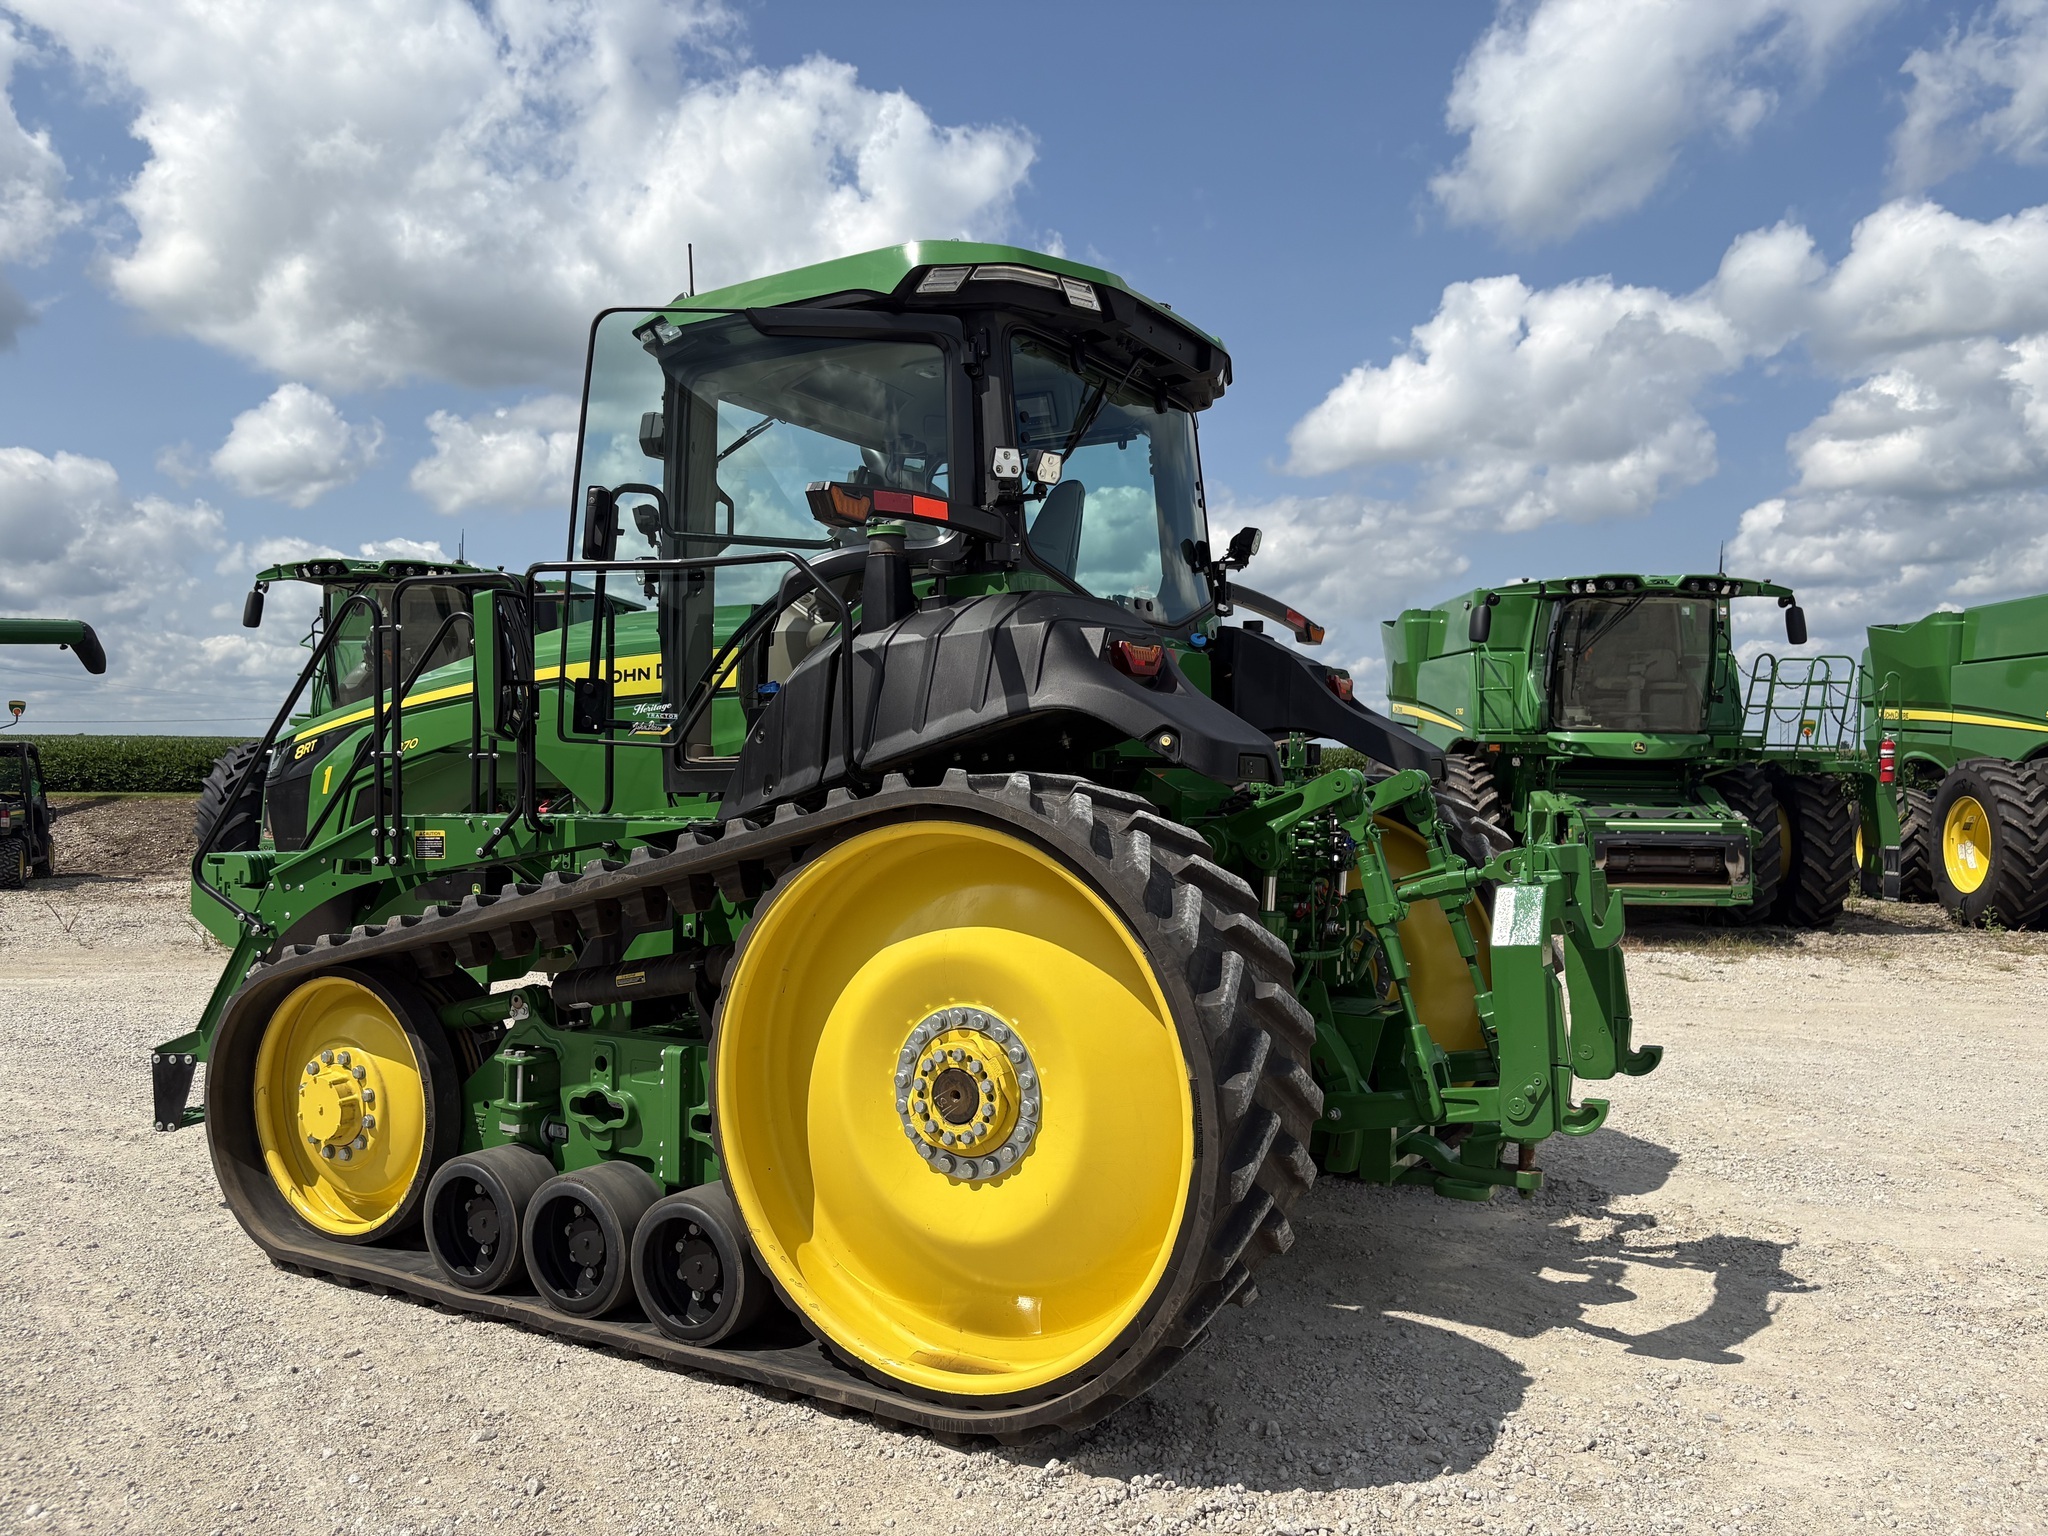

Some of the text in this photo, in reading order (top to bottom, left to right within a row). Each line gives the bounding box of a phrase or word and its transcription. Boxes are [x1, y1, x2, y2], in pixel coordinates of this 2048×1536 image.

[613, 667, 651, 684] OHN
[633, 703, 672, 715] Heritage
[294, 739, 318, 760] 8RT
[400, 737, 419, 752] 70
